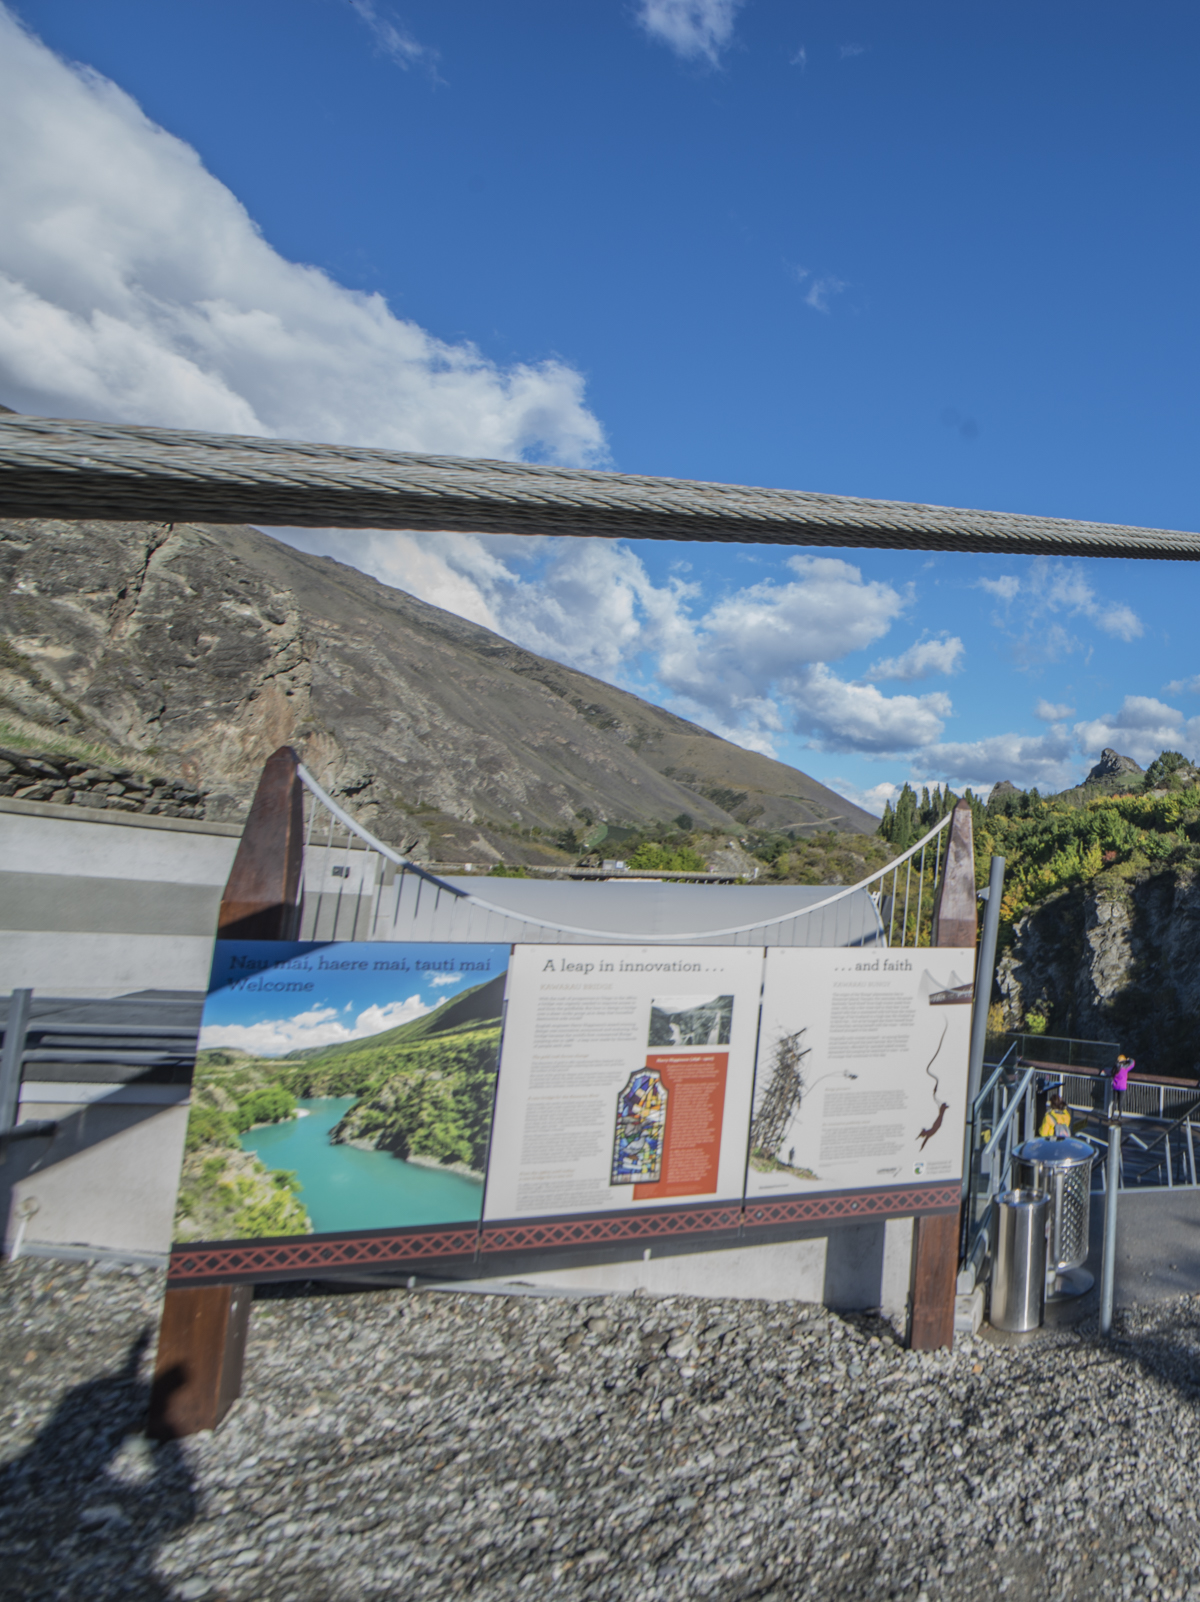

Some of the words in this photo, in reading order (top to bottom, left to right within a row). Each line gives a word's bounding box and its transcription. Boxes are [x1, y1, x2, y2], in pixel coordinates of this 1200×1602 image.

[229, 955, 270, 970] Nau
[274, 956, 312, 972] mai,
[317, 955, 367, 971] haere
[373, 957, 410, 973] mai,
[415, 957, 455, 972] tauti
[459, 957, 491, 972] mai
[542, 959, 556, 972] A
[560, 958, 595, 975] leap
[599, 959, 614, 972] in
[619, 959, 702, 973] innovation
[855, 958, 880, 972] and
[883, 958, 913, 972] faith
[226, 977, 315, 992] Welcome
